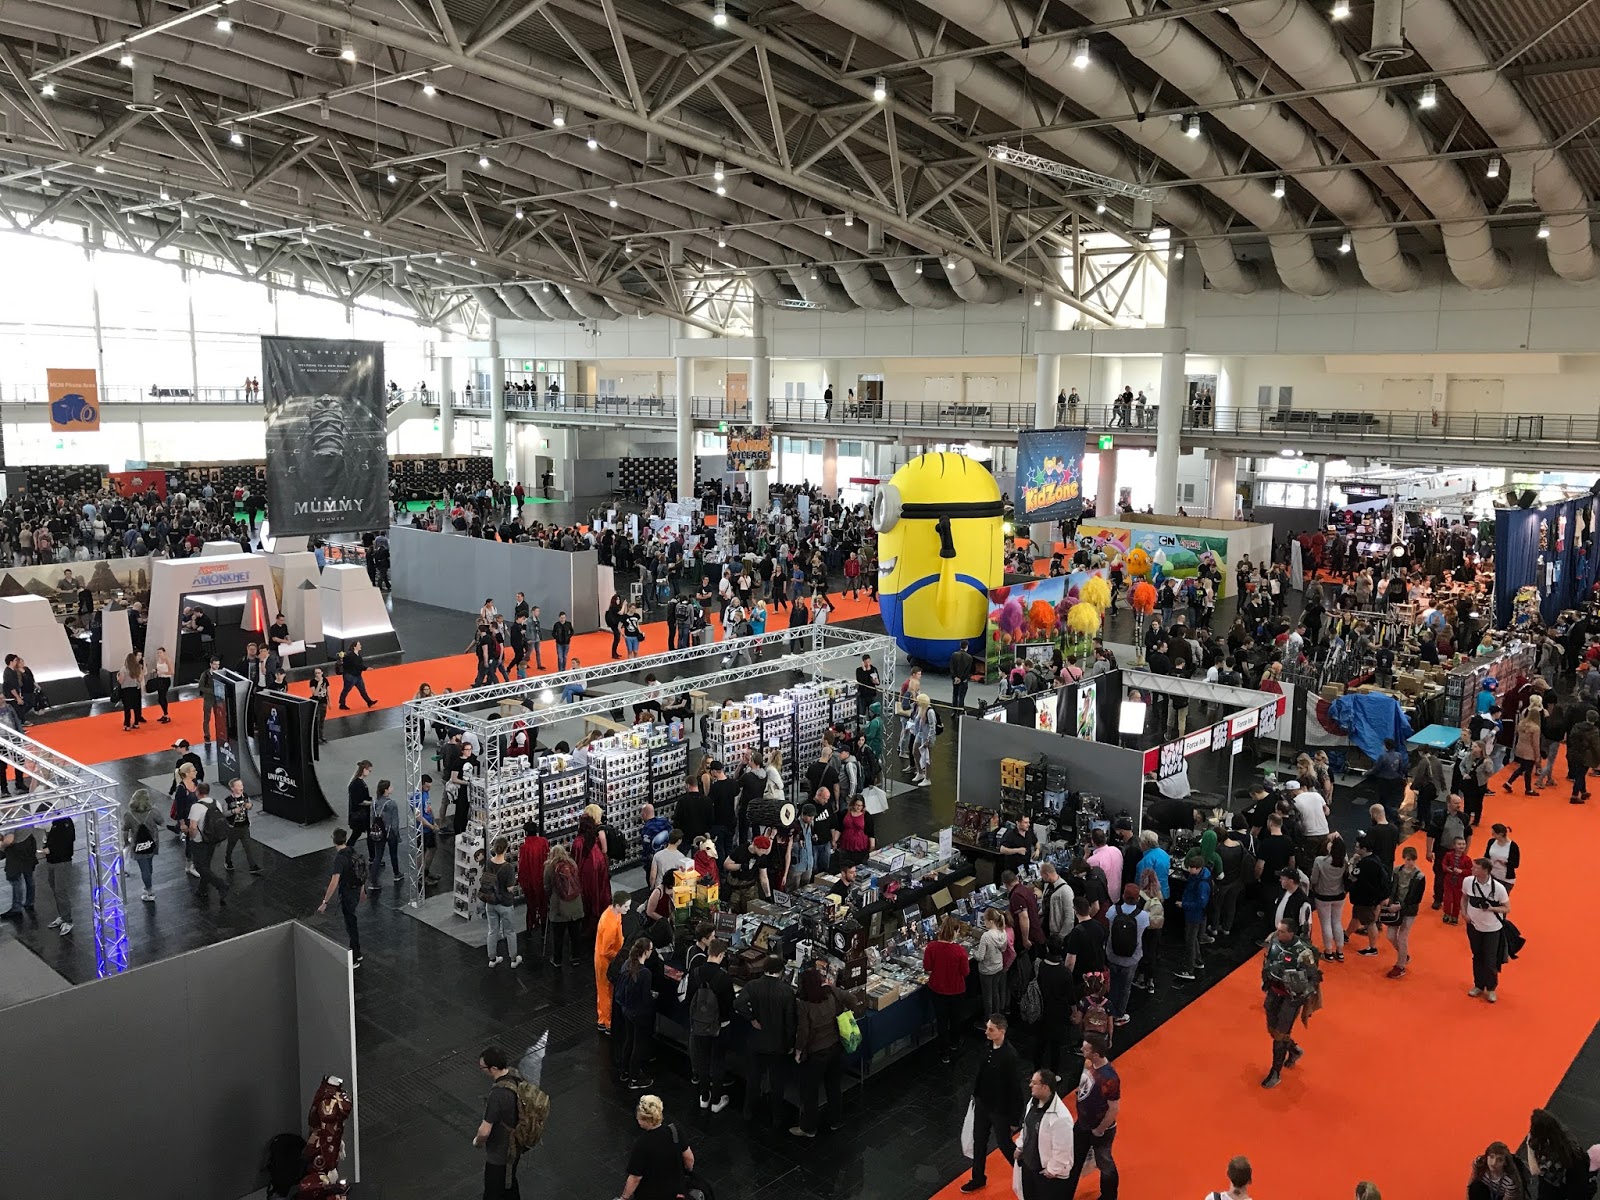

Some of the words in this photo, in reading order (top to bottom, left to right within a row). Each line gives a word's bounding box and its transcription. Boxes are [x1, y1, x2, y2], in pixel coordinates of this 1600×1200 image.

[730, 438, 770, 452] COMIC
[732, 451, 768, 460] VILLAGE
[1025, 481, 1079, 513] KidZone
[294, 498, 364, 516] MUMMY
[159, 535, 176, 546] CN
[192, 571, 250, 587] AMONKHET
[1237, 719, 1247, 728] Force
[1186, 741, 1198, 750] Force
[267, 772, 298, 788] UNIVERSAL
